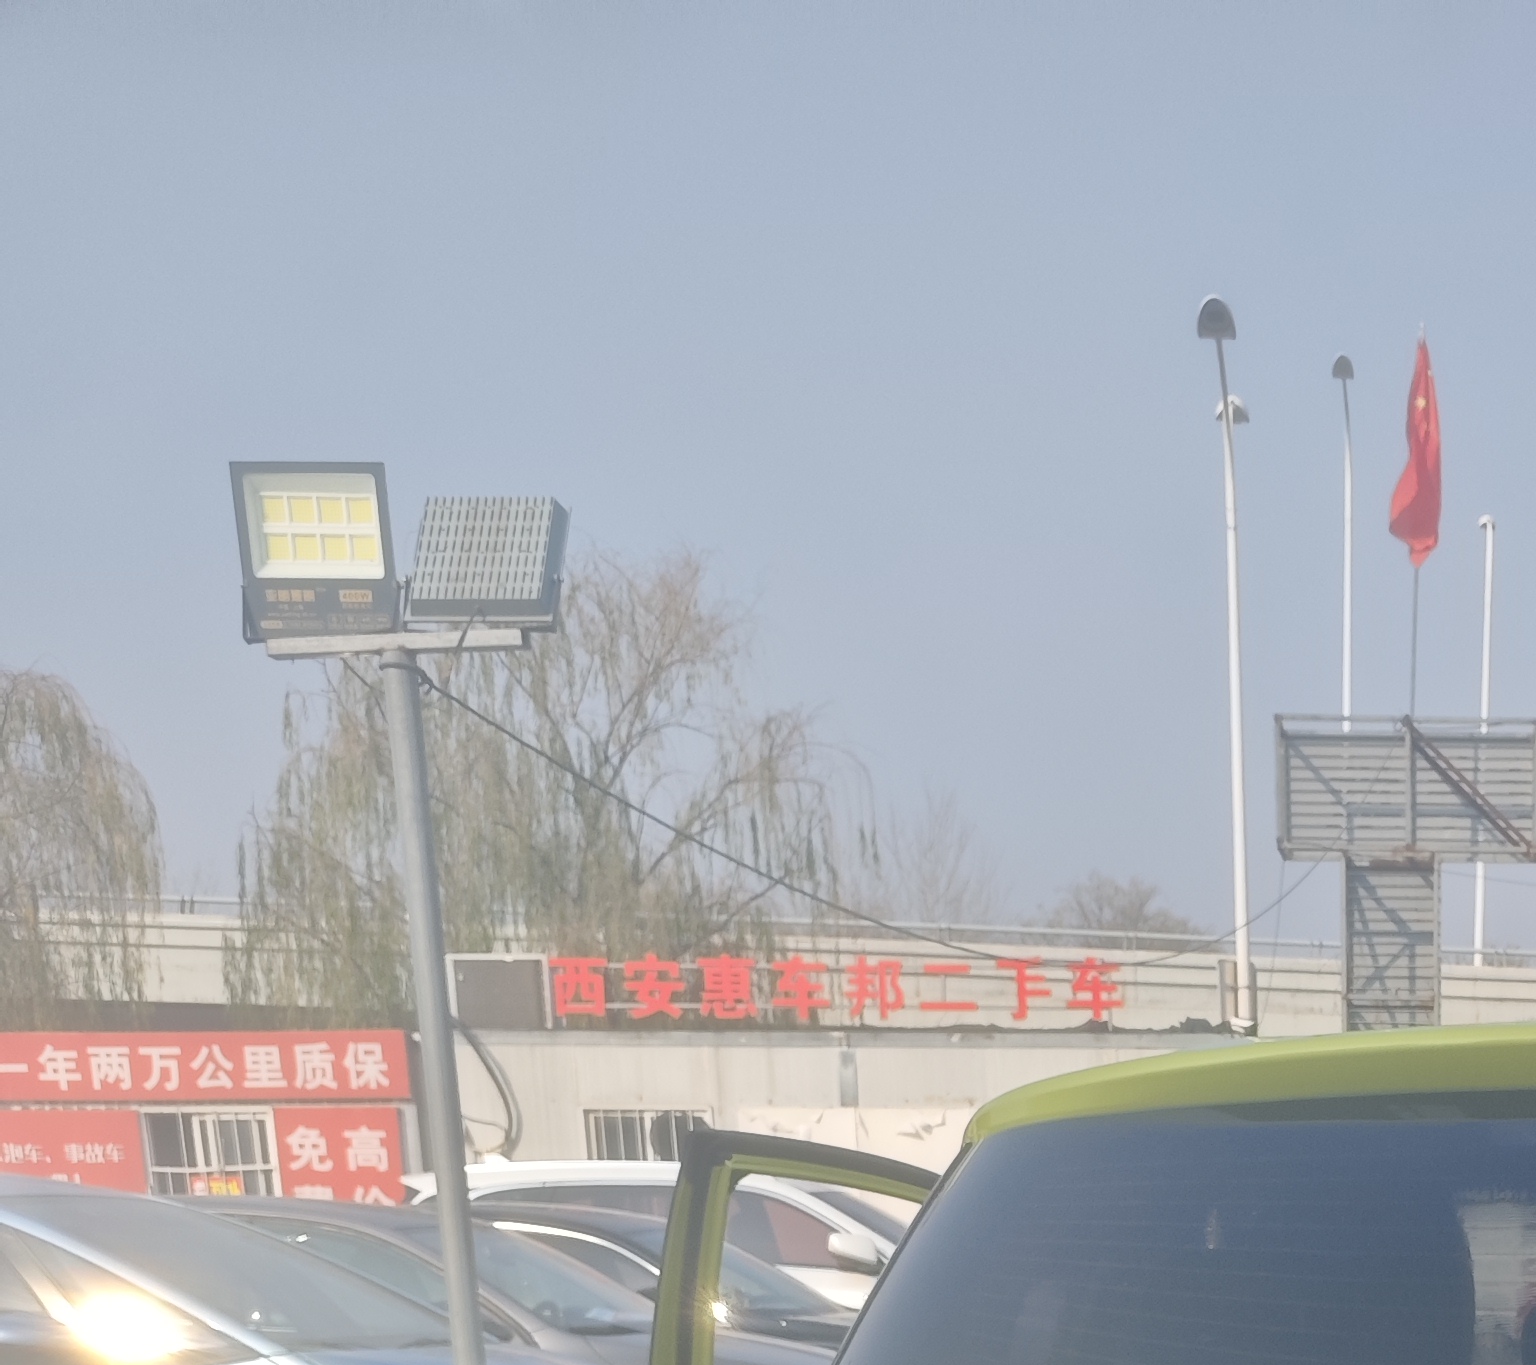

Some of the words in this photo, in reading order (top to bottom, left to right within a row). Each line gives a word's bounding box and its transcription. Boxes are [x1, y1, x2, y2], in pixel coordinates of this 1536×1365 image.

[548, 953, 1124, 1021] 西安惠车邦二手车
[0, 1041, 391, 1091] 一年两万公里质保
[0, 1142, 126, 1164] 泡车、事故车
